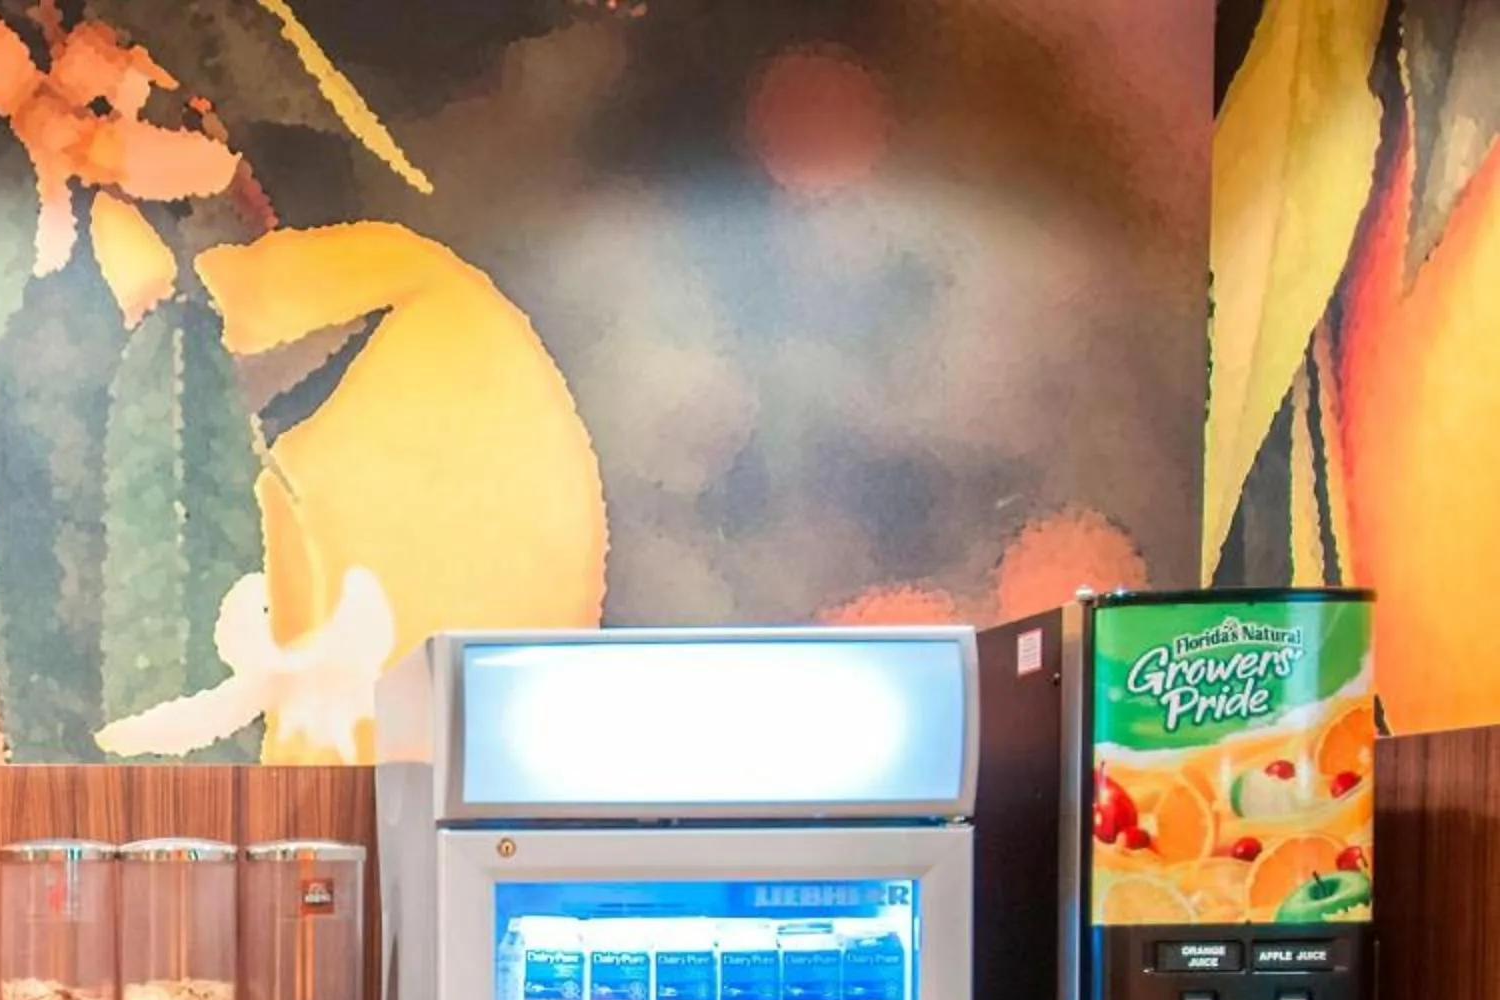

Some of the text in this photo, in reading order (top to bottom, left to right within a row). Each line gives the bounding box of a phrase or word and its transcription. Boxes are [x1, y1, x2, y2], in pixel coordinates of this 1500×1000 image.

[1176, 625, 1302, 654] Florida's Natural
[1160, 678, 1269, 730] Pride
[1181, 945, 1226, 956] ORANGE
[1259, 951, 1327, 961] APPLE JUICE
[1188, 958, 1219, 967] JUICE
